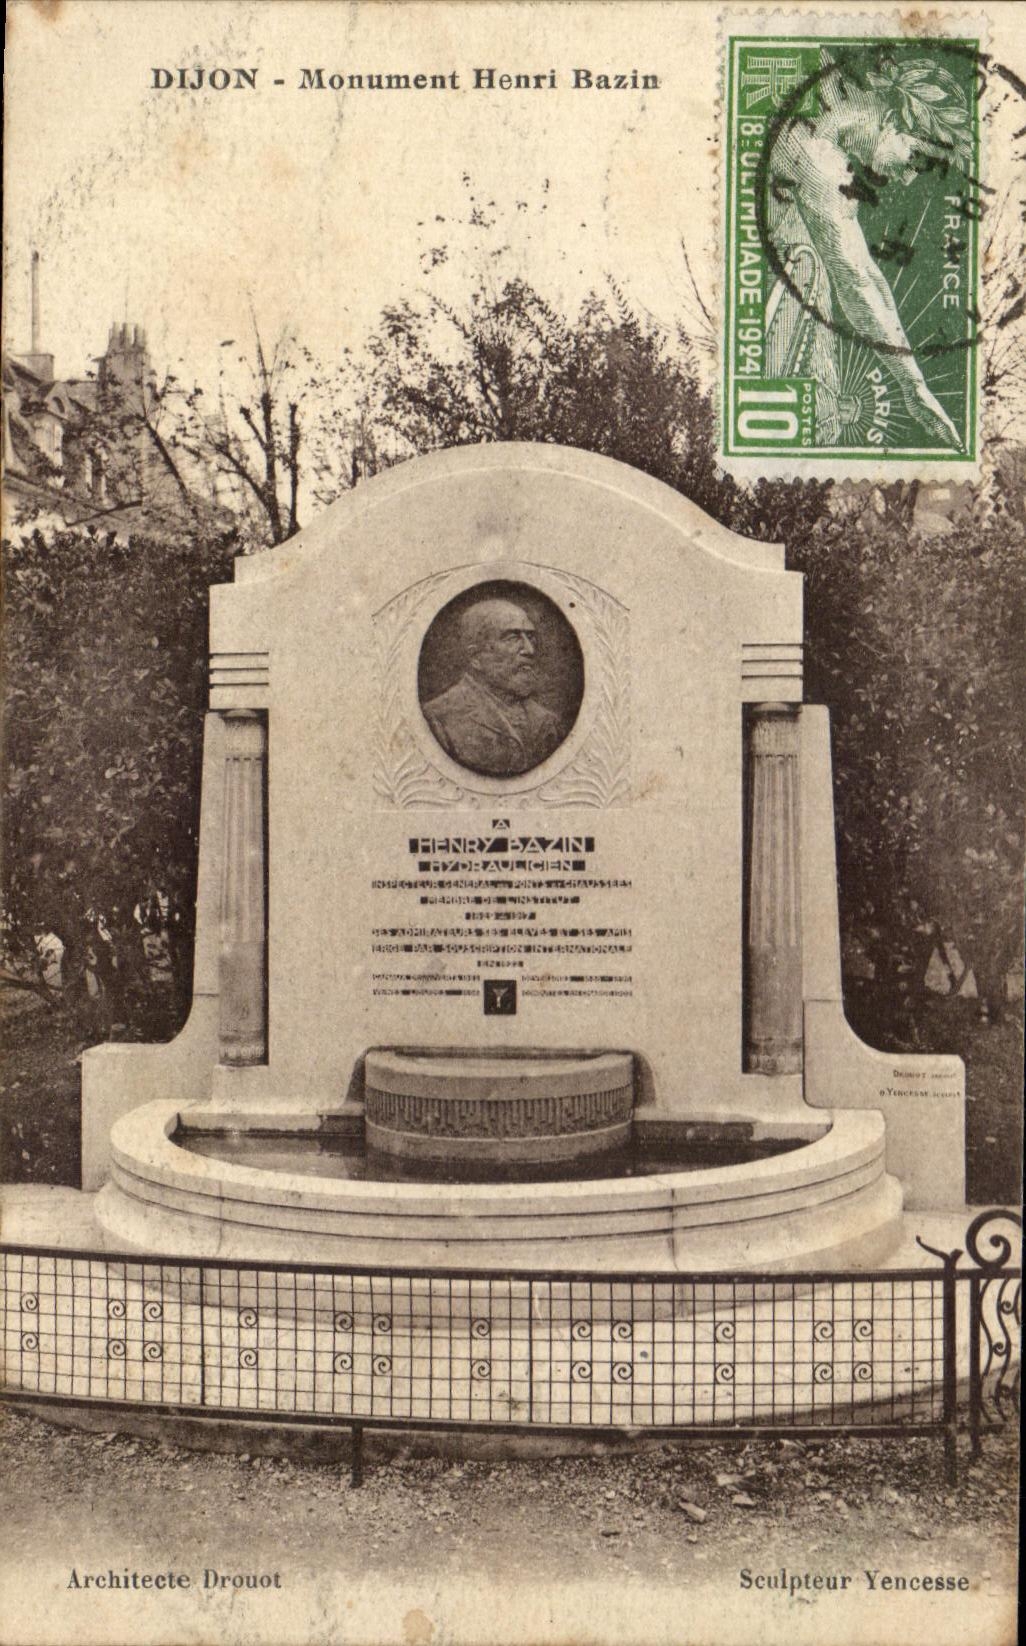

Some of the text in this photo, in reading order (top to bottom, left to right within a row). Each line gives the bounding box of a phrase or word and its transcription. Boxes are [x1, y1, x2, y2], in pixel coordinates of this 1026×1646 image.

[944, 195, 961, 309] FRANCE
[737, 384, 799, 440] 10
[801, 382, 812, 447] POSTES
[866, 367, 891, 444] PARIS
[417, 837, 586, 853] HENRY BAZIN
[493, 819, 510, 829] A
[429, 860, 573, 872] HYDRAULICIEN
